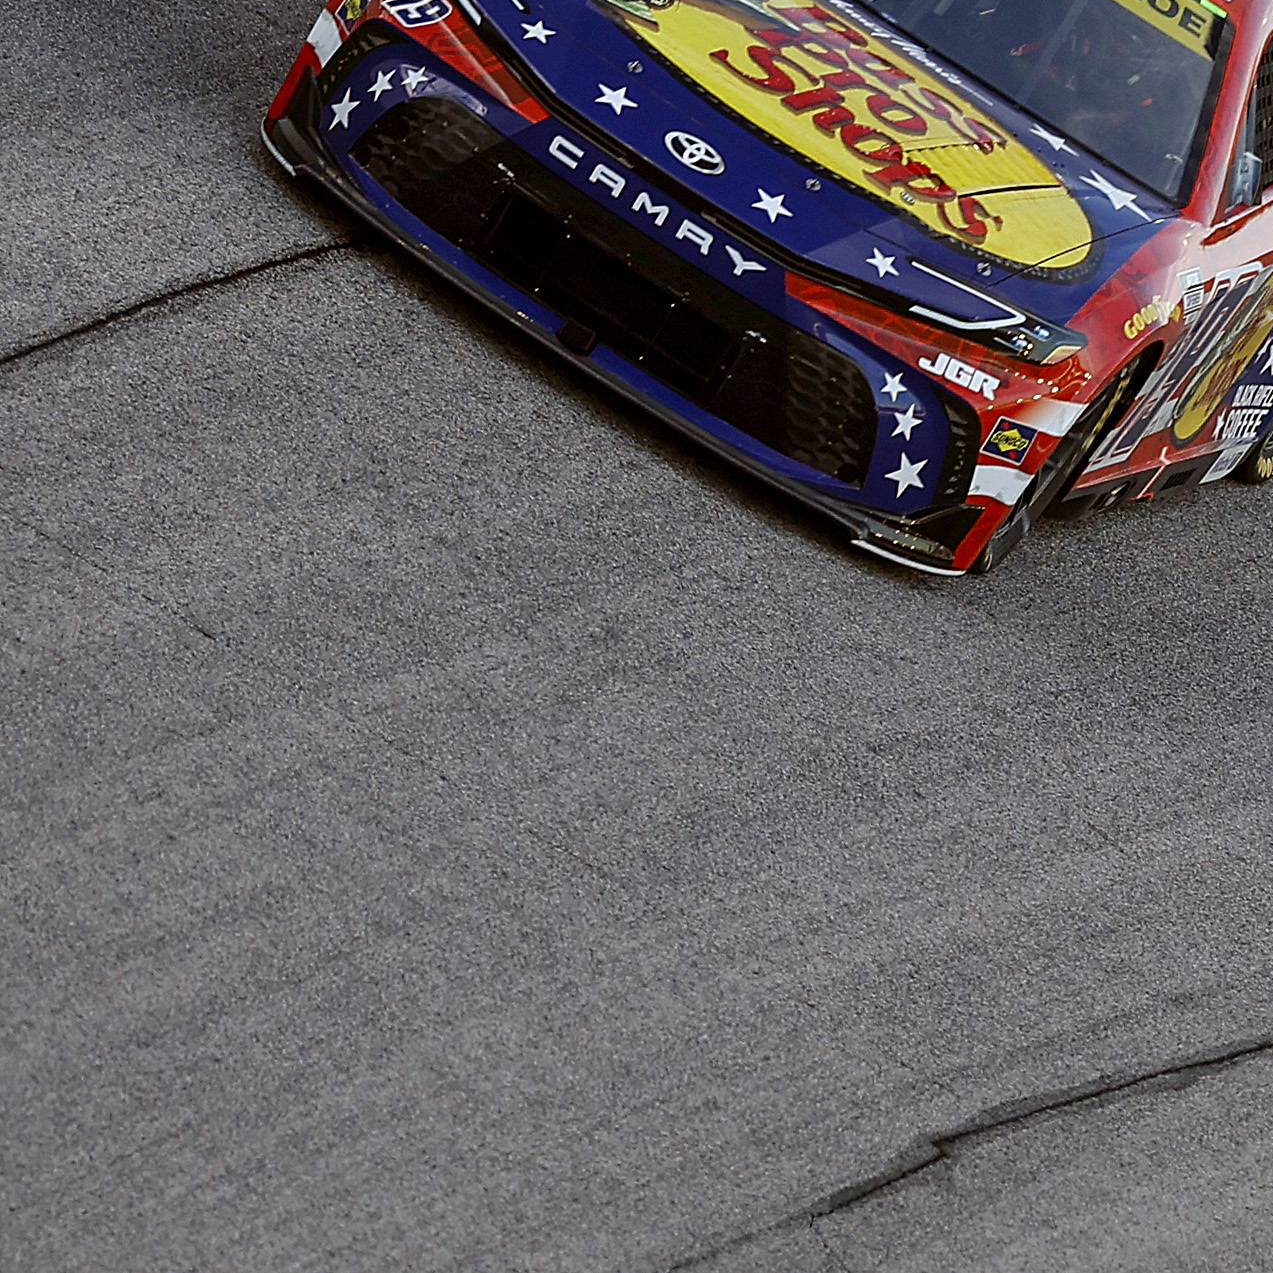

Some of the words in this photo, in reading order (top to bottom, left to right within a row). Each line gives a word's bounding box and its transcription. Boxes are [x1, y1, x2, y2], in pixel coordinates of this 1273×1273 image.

[744, 19, 928, 136] Pro
[767, 4, 1007, 155] Bass
[548, 134, 767, 277] CAMRY
[708, 44, 1004, 245] Shops
[917, 342, 1000, 401] JGR
[1221, 408, 1270, 440] COFFEE
